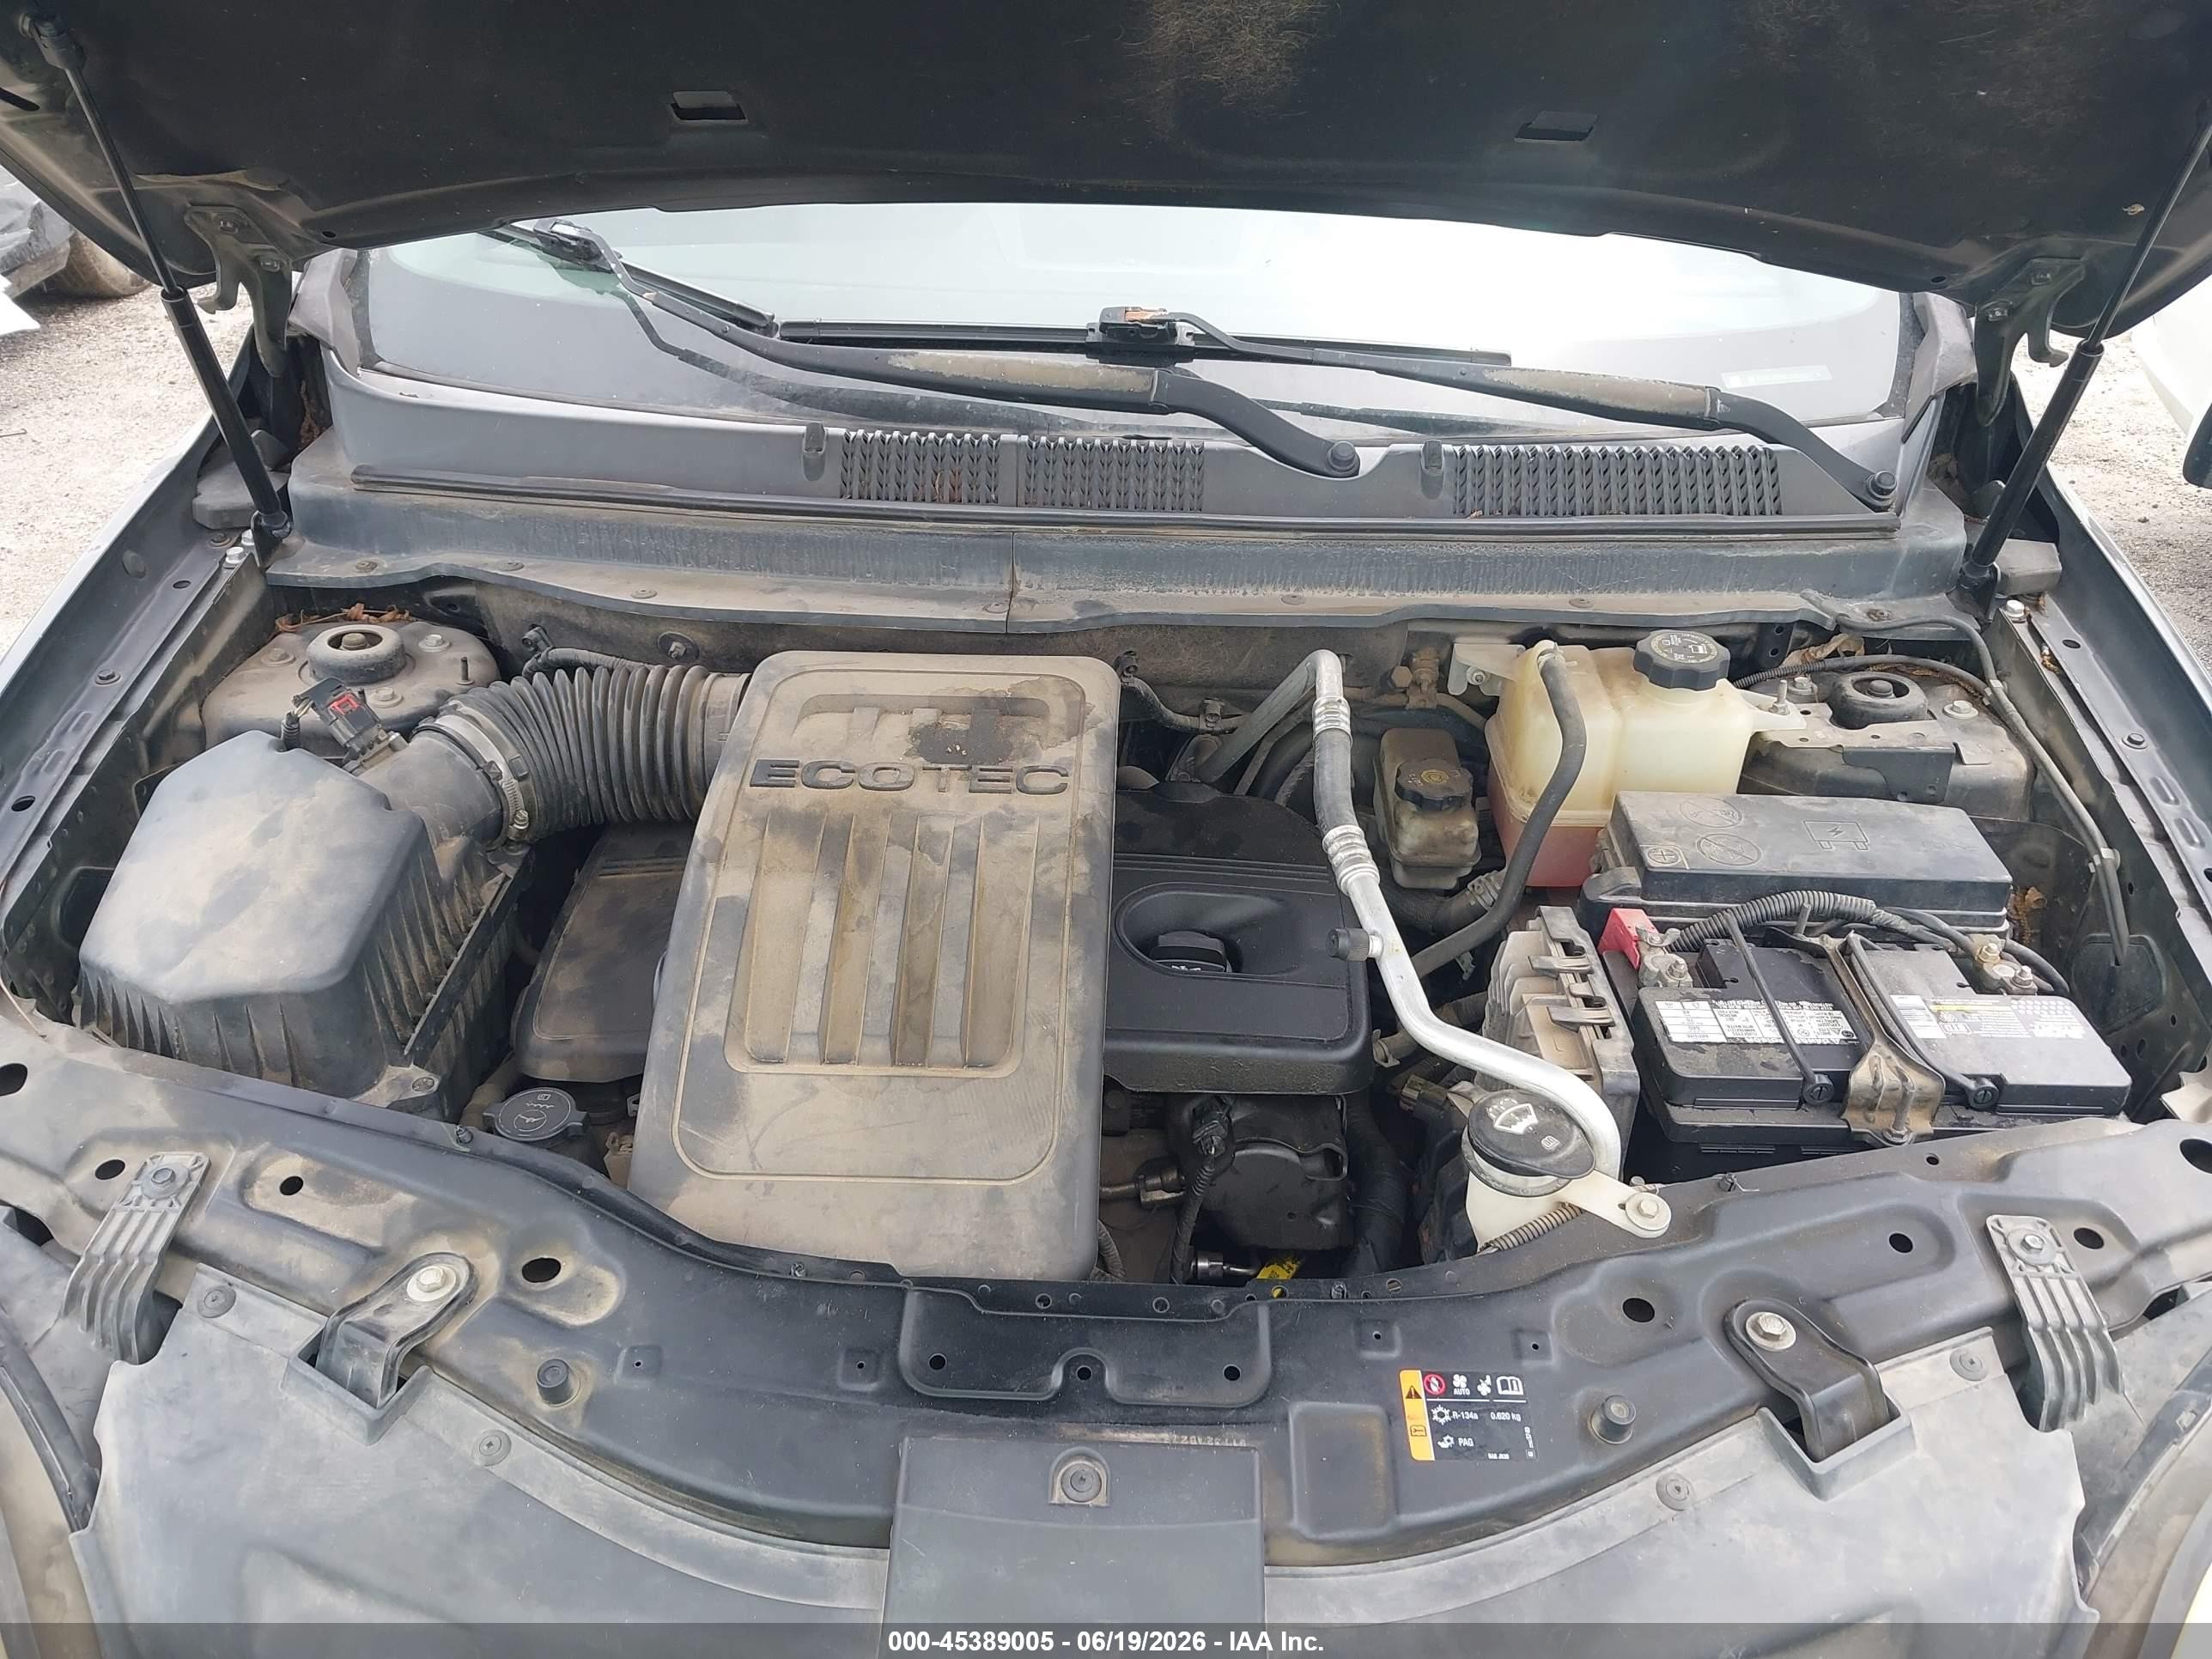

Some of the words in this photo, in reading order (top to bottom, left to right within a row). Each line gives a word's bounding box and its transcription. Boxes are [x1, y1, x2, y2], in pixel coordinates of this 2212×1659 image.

[749, 758, 1070, 796] ECOTEC
[1452, 1411, 1479, 1420] R-134a
[1457, 1437, 1474, 1447] PAG
